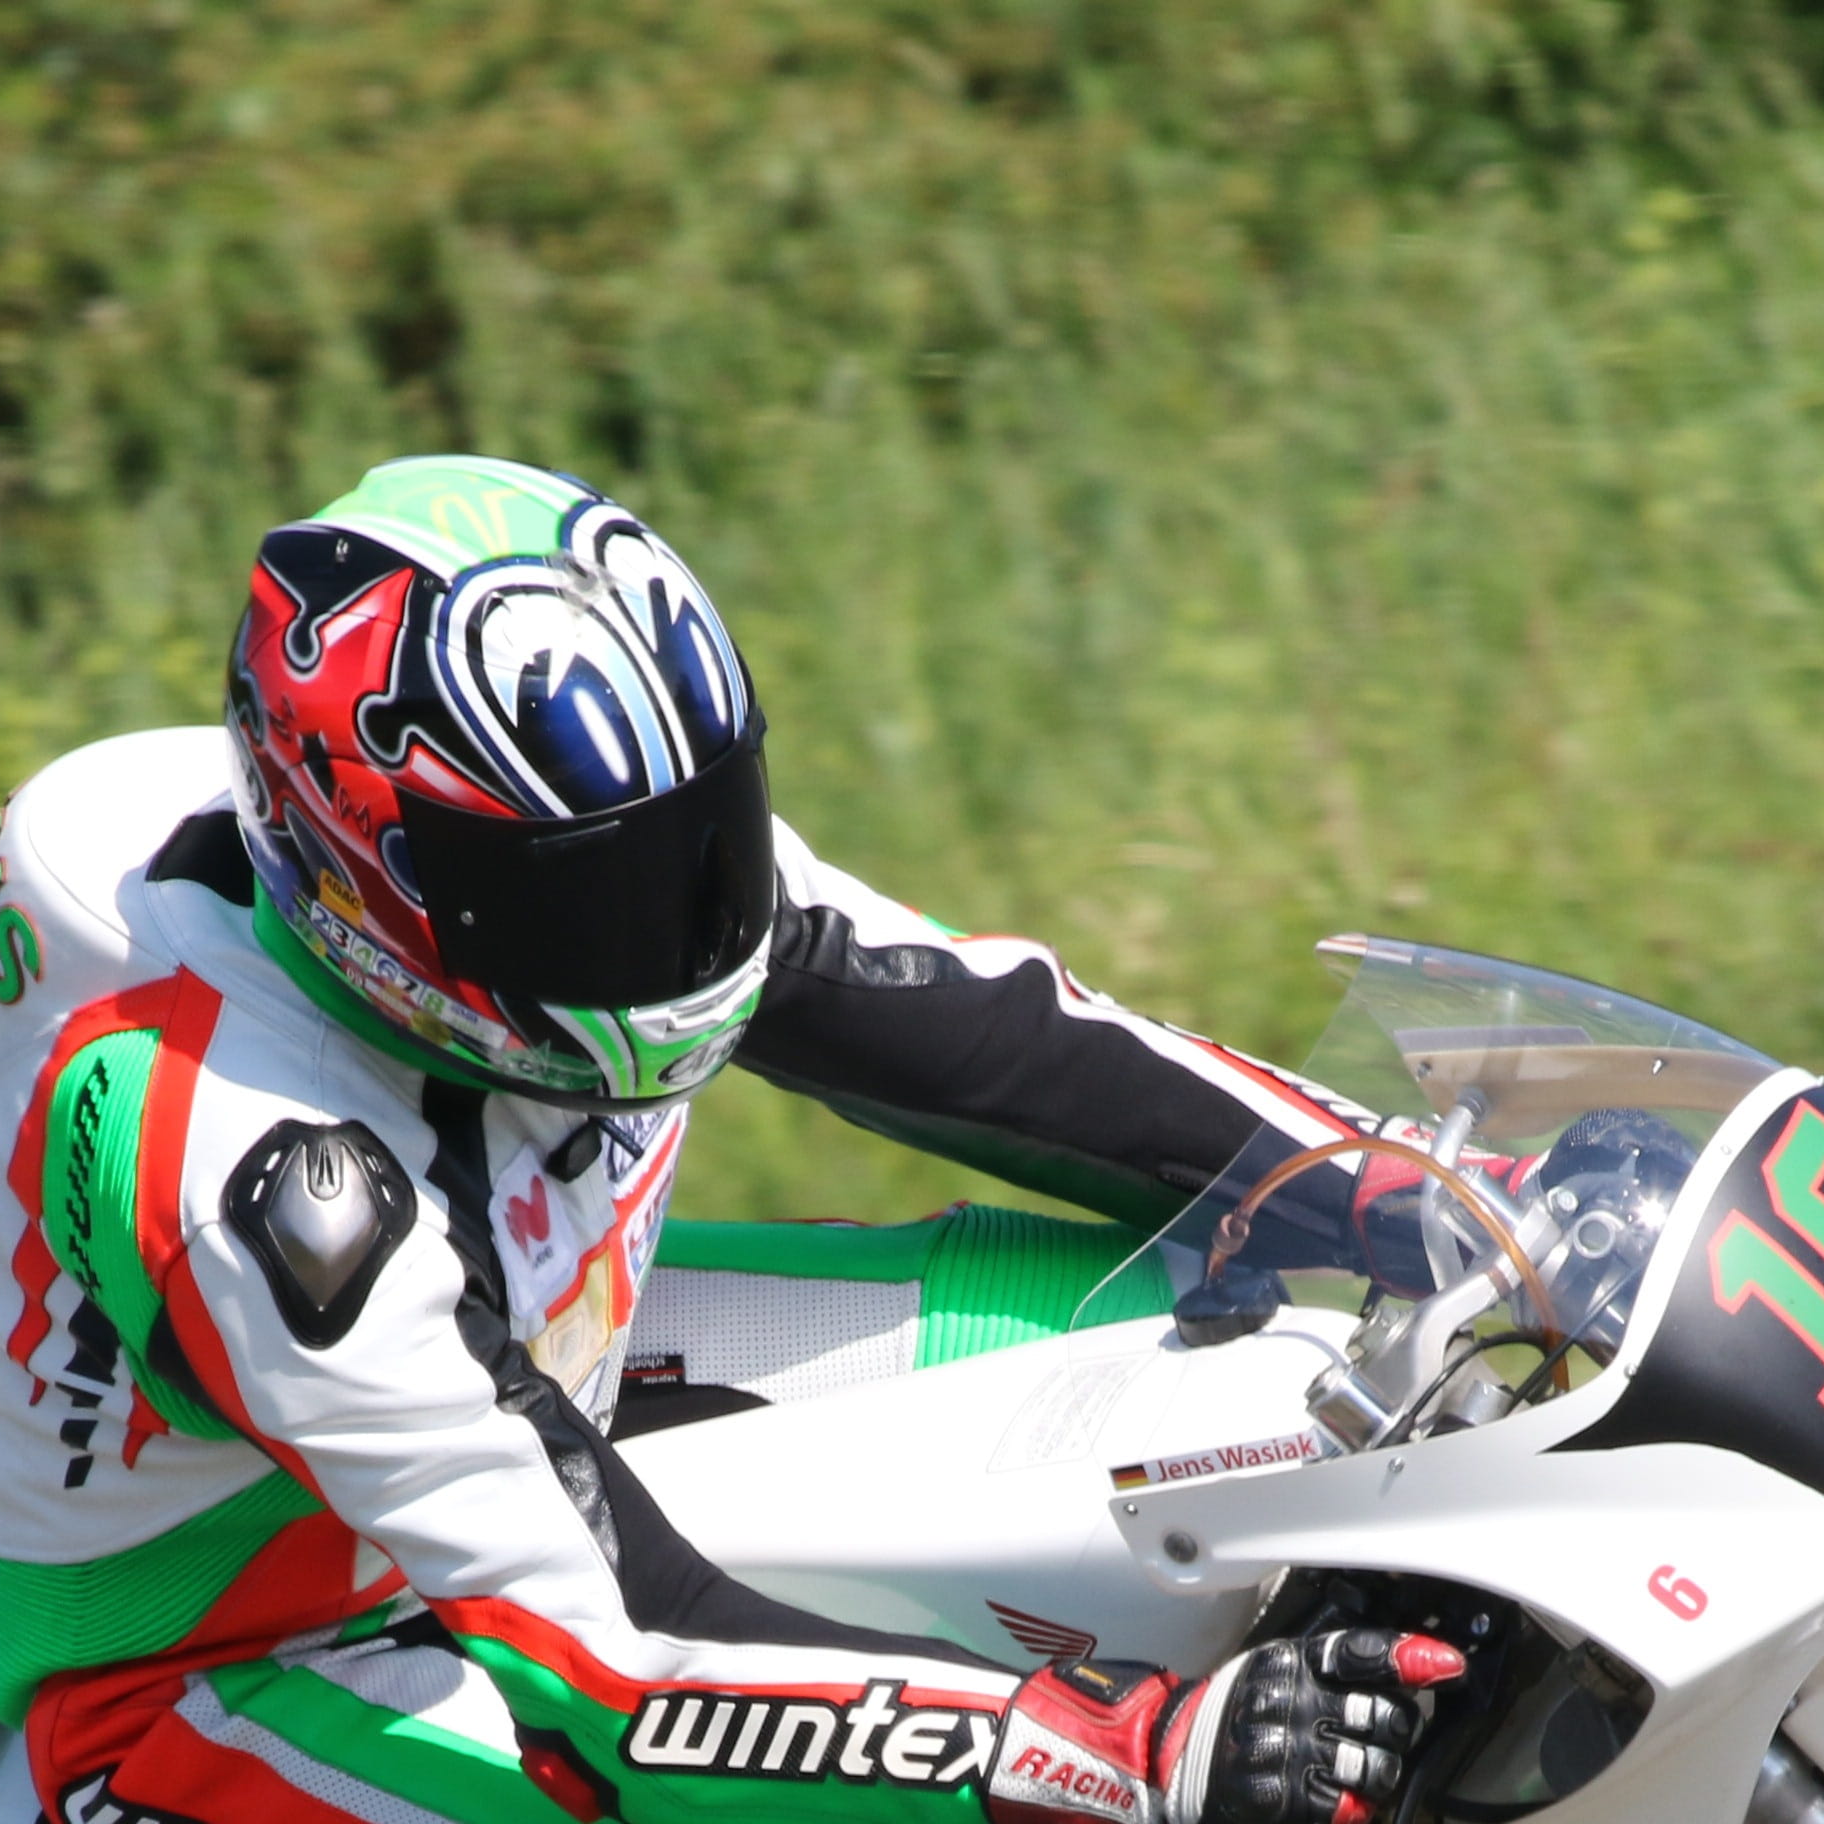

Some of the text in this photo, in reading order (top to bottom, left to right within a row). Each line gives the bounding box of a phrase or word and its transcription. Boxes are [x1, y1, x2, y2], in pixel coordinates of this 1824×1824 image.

[1157, 1432, 1318, 1483] Jens Wasiak
[1648, 1565, 1709, 1622] 6
[628, 1683, 998, 1783] wintex
[1012, 1745, 1136, 1810] RACING
